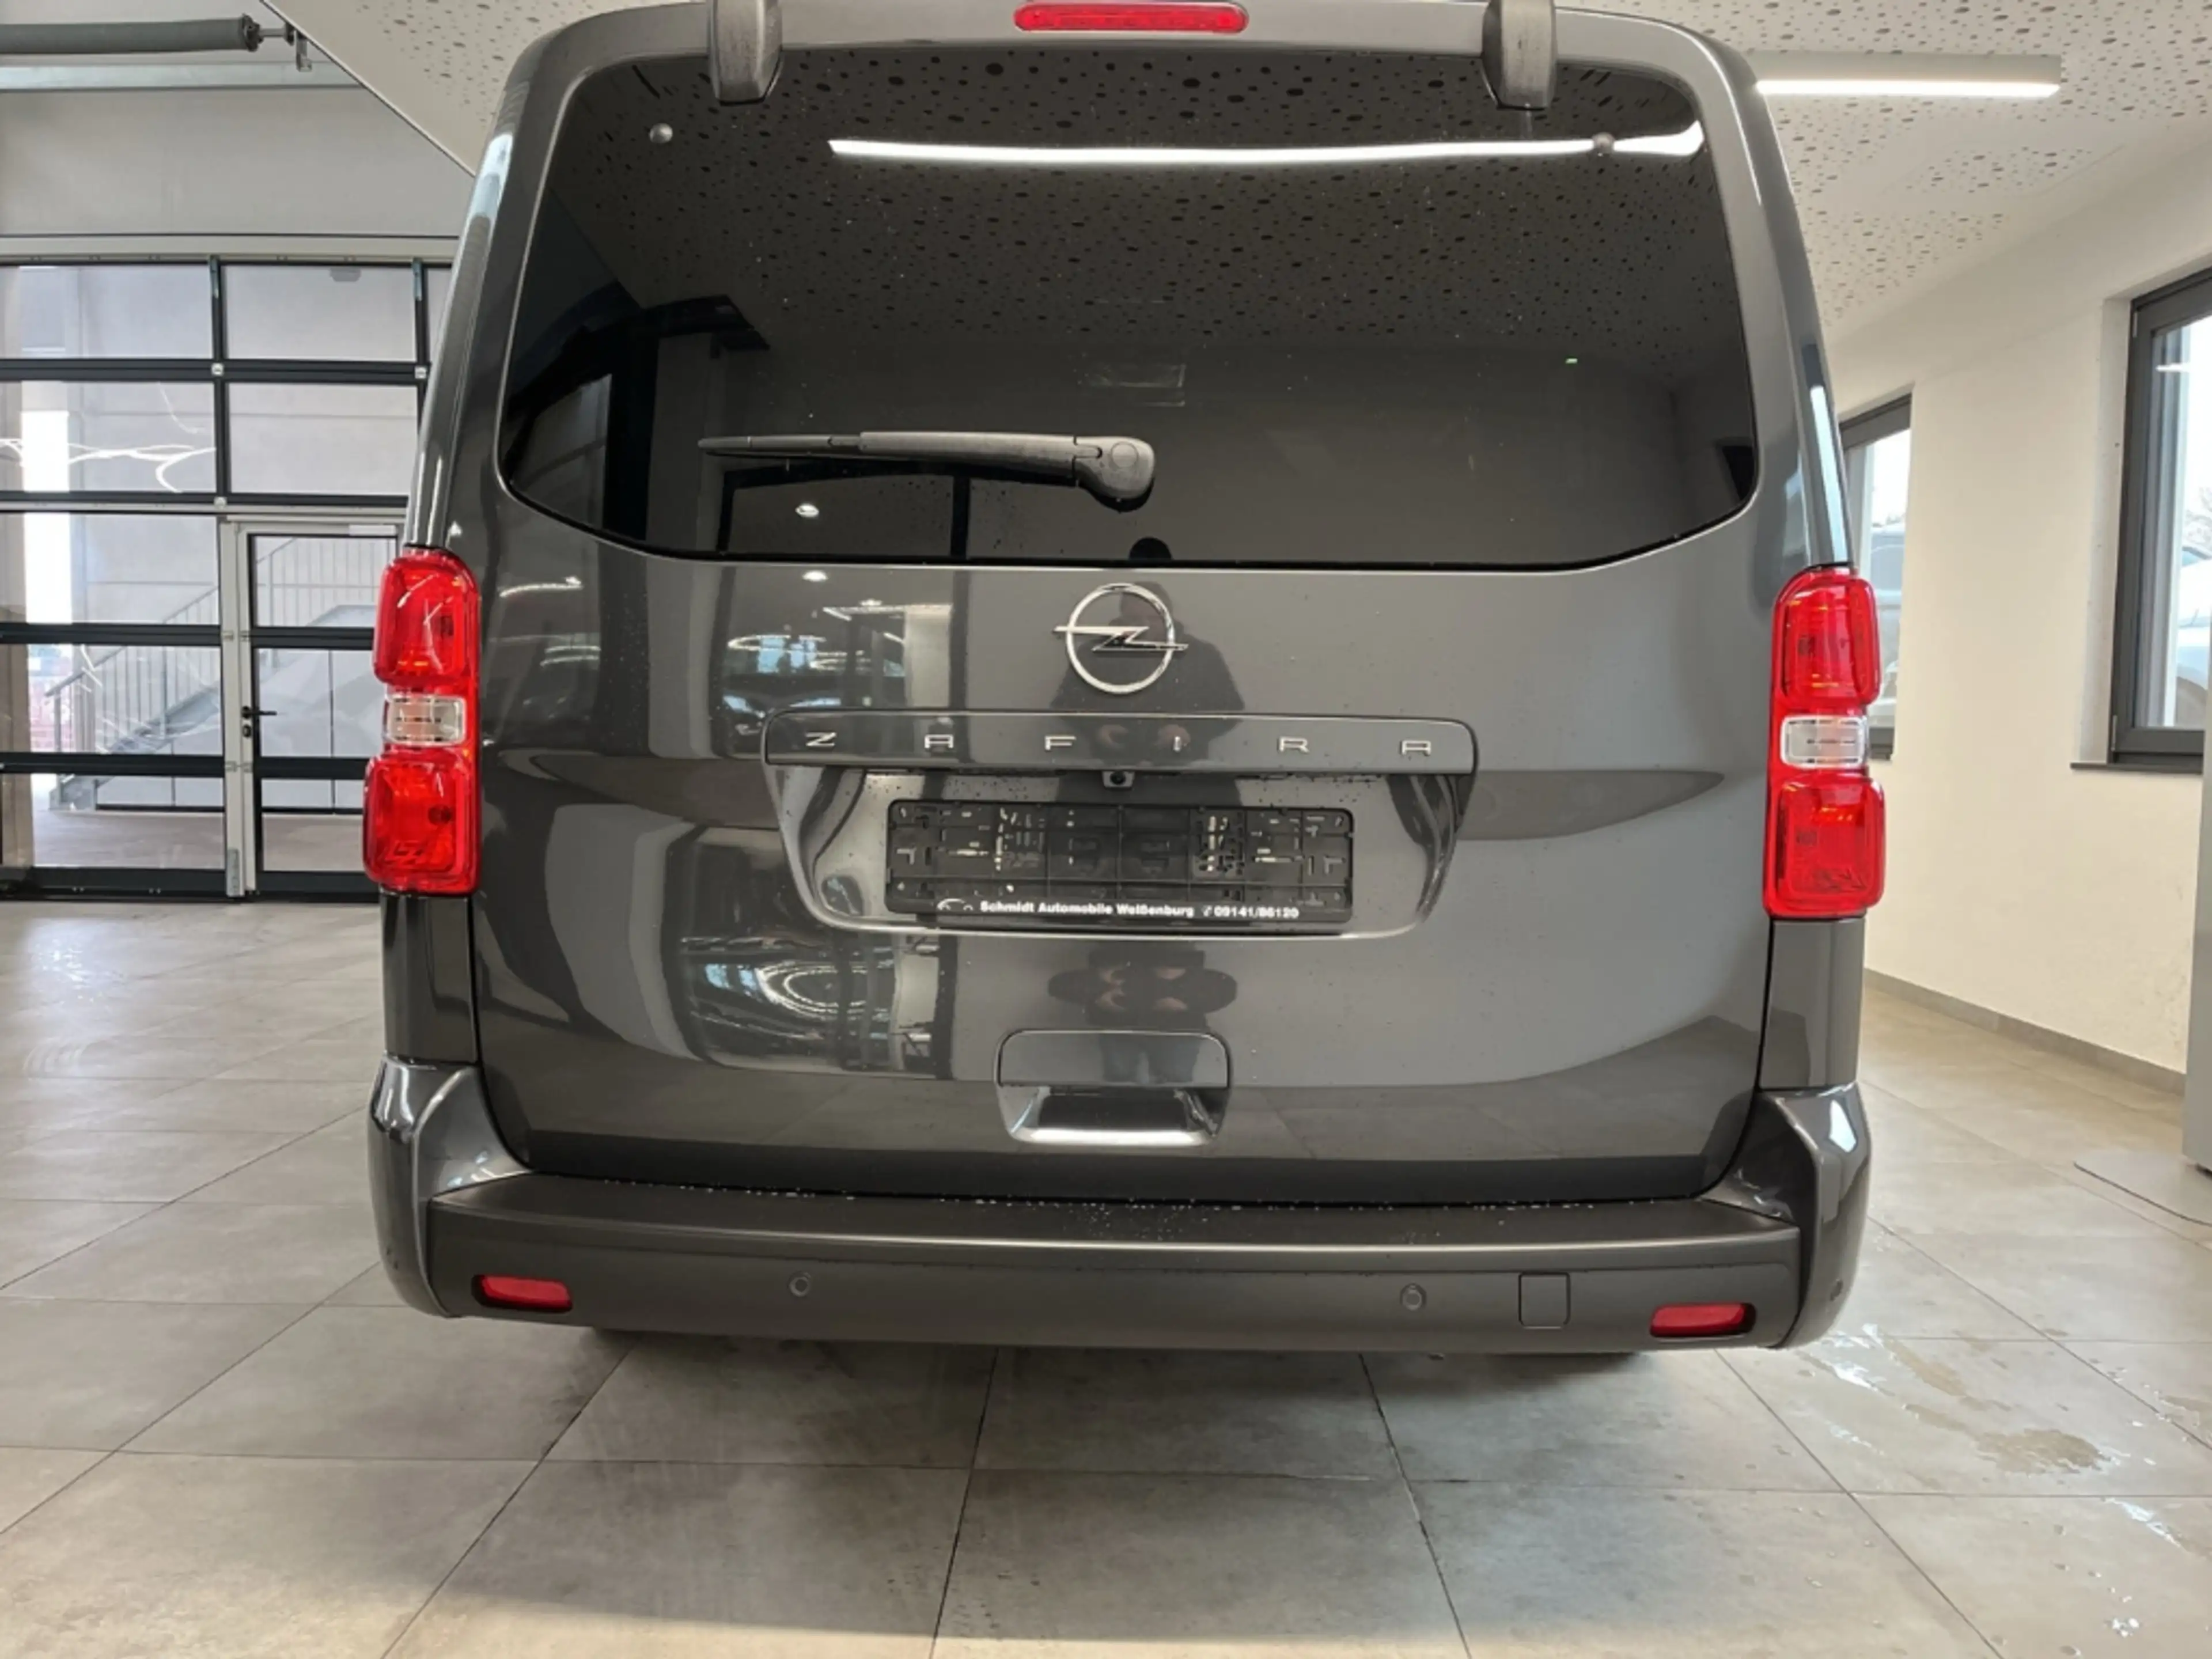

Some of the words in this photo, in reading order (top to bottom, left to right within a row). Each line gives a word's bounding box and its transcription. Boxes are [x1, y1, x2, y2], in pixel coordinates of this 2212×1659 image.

[805, 732, 1431, 756] ZAFIRA
[980, 900, 1035, 913] Schmidt
[1038, 902, 1113, 915] Automobile
